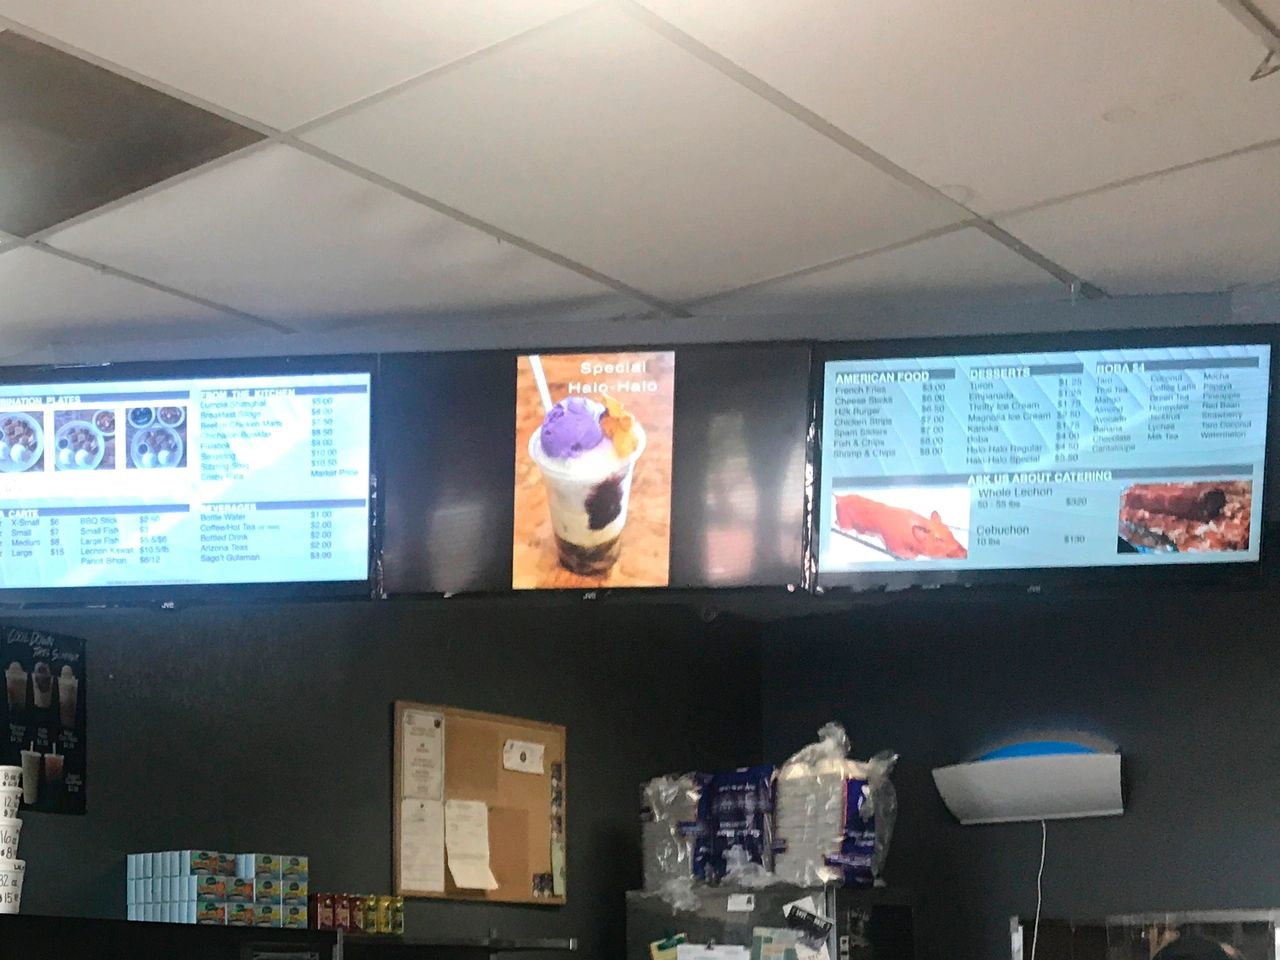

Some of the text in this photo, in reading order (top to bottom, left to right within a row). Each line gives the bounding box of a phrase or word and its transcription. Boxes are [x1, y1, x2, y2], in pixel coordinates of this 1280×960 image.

[581, 361, 646, 375] Special
[836, 371, 929, 384] AMERICAN FOOD
[569, 381, 658, 395] Halo-Halo
[46, 396, 80, 404] PLATES
[968, 471, 1112, 486] ASK US ABOUT CATERING
[979, 487, 1053, 497] Whole Lechon
[977, 525, 1029, 535] Cebuchon
